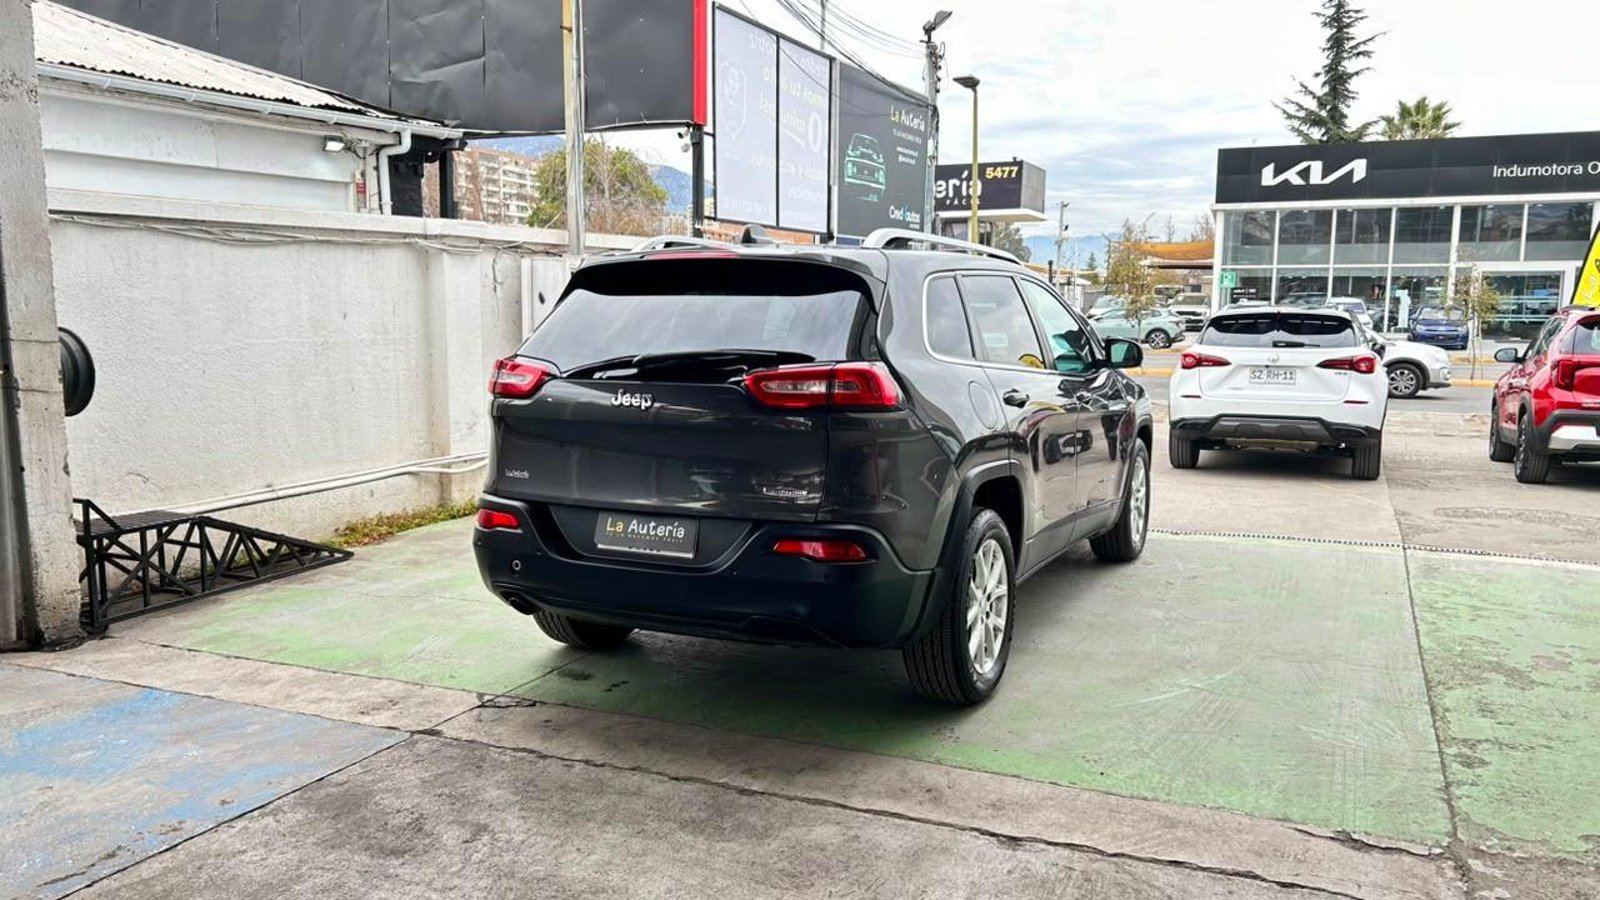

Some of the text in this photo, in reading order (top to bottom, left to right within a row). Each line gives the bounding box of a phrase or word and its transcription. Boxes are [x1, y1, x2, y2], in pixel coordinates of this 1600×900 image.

[985, 166, 1018, 180] 5477
[1492, 163, 1583, 178] Indumotora
[610, 389, 652, 410] Jeep
[606, 516, 624, 532] La
[628, 519, 685, 539] Autería
